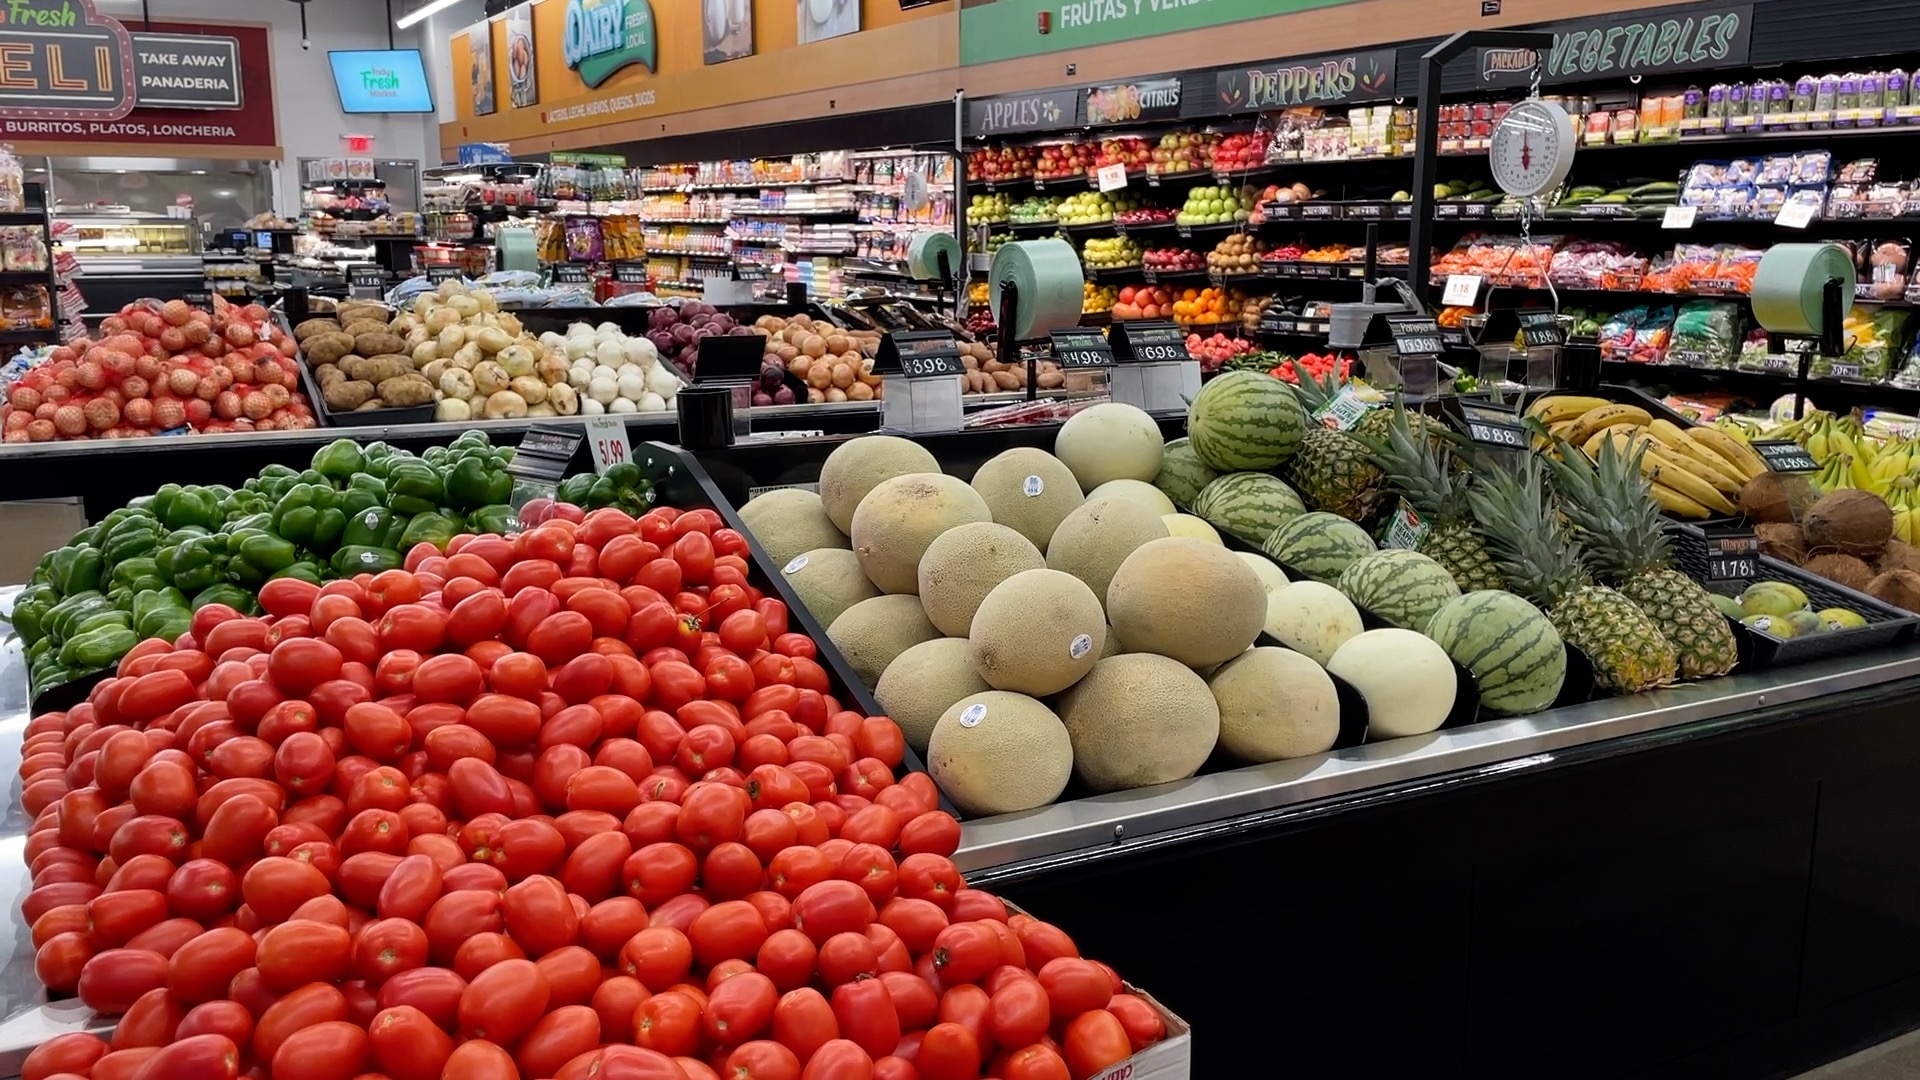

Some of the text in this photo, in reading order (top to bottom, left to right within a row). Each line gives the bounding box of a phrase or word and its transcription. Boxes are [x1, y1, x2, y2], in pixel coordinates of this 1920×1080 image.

[7, 0, 76, 27] Fresh
[1060, 0, 1128, 28] FRUTAS
[626, 31, 647, 49] LOCAL
[1548, 13, 1740, 77] VEGETABLES
[0, 42, 113, 92] ELI
[139, 52, 226, 68] TAKE AWAY
[141, 75, 229, 91] PANADERIA
[360, 70, 399, 90] Fresh
[1245, 57, 1356, 108] PEPPERS
[1139, 88, 1181, 109] CITRUS
[981, 98, 1041, 131] APPLES
[6, 121, 236, 137] BURRITOS, PLATOS, LONCHERIA
